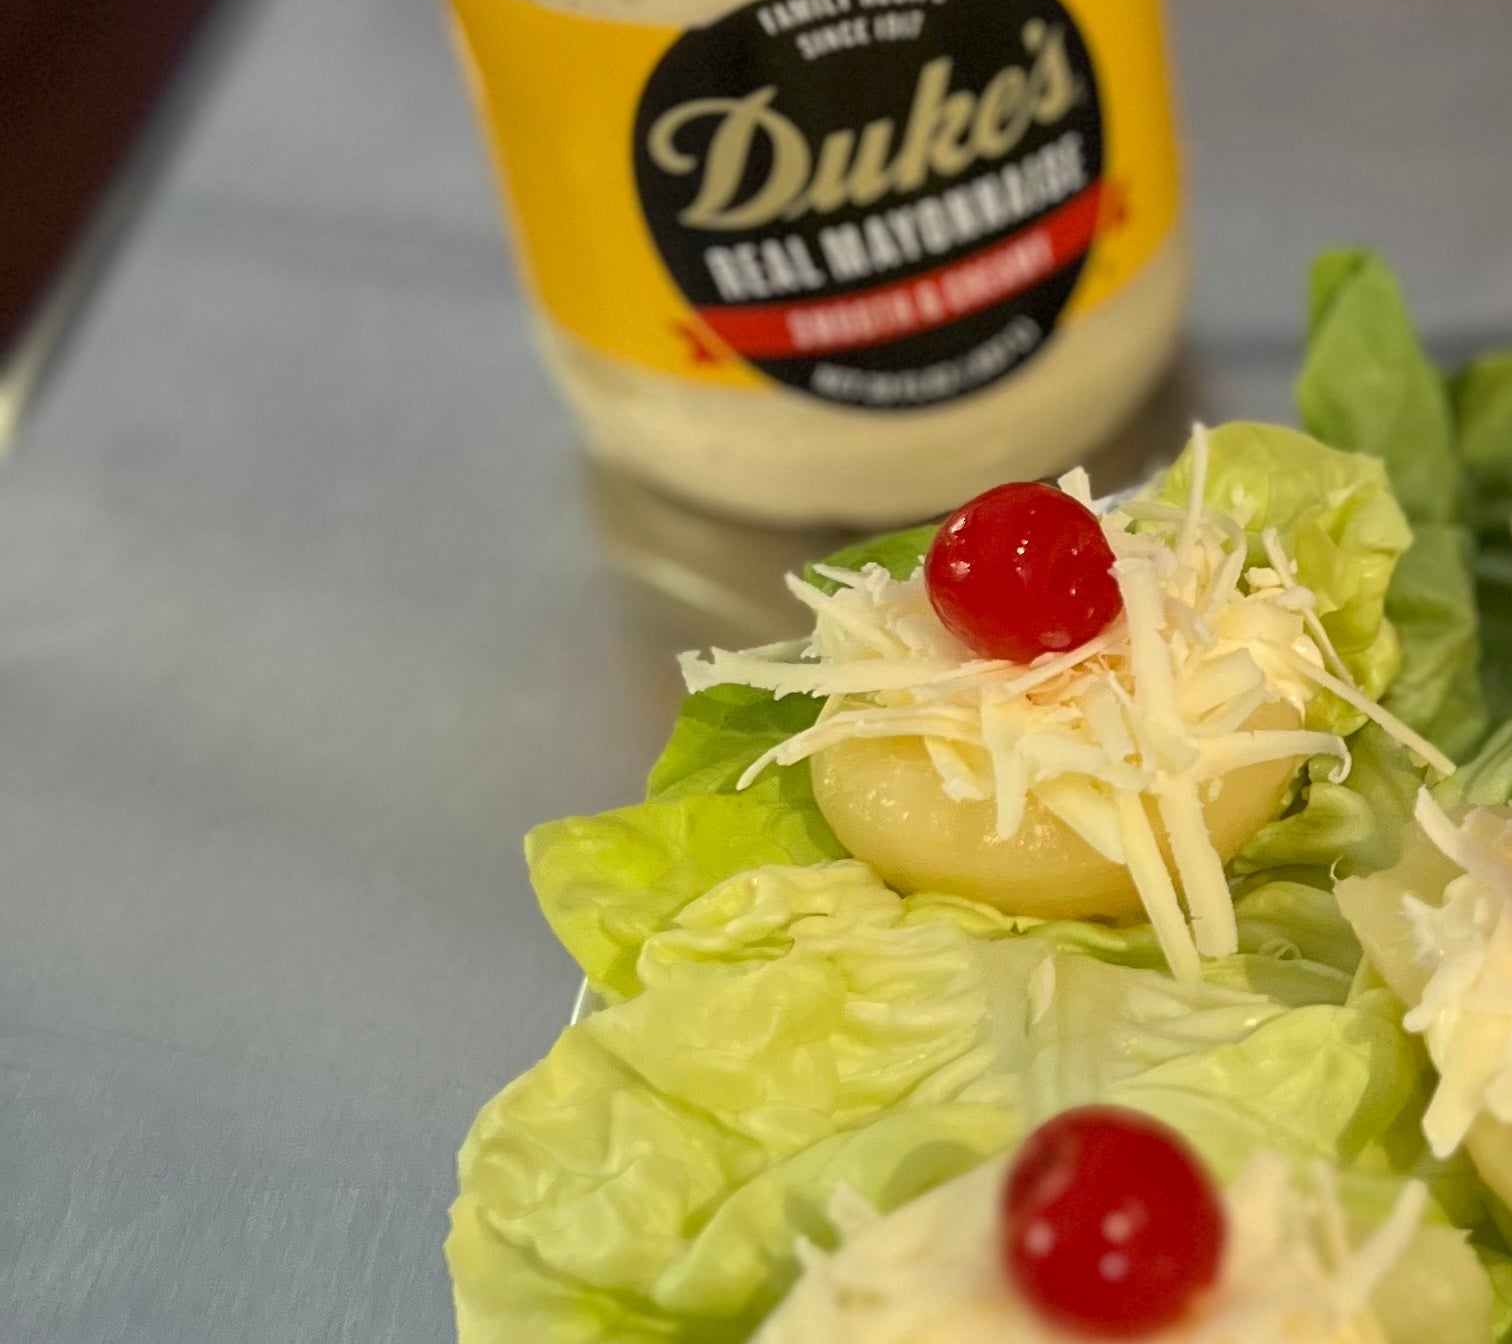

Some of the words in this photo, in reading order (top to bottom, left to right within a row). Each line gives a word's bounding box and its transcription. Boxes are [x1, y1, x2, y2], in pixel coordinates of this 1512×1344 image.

[796, 16, 871, 61] SINCE
[647, 17, 1082, 231] Duke's
[705, 234, 826, 303] REAL
